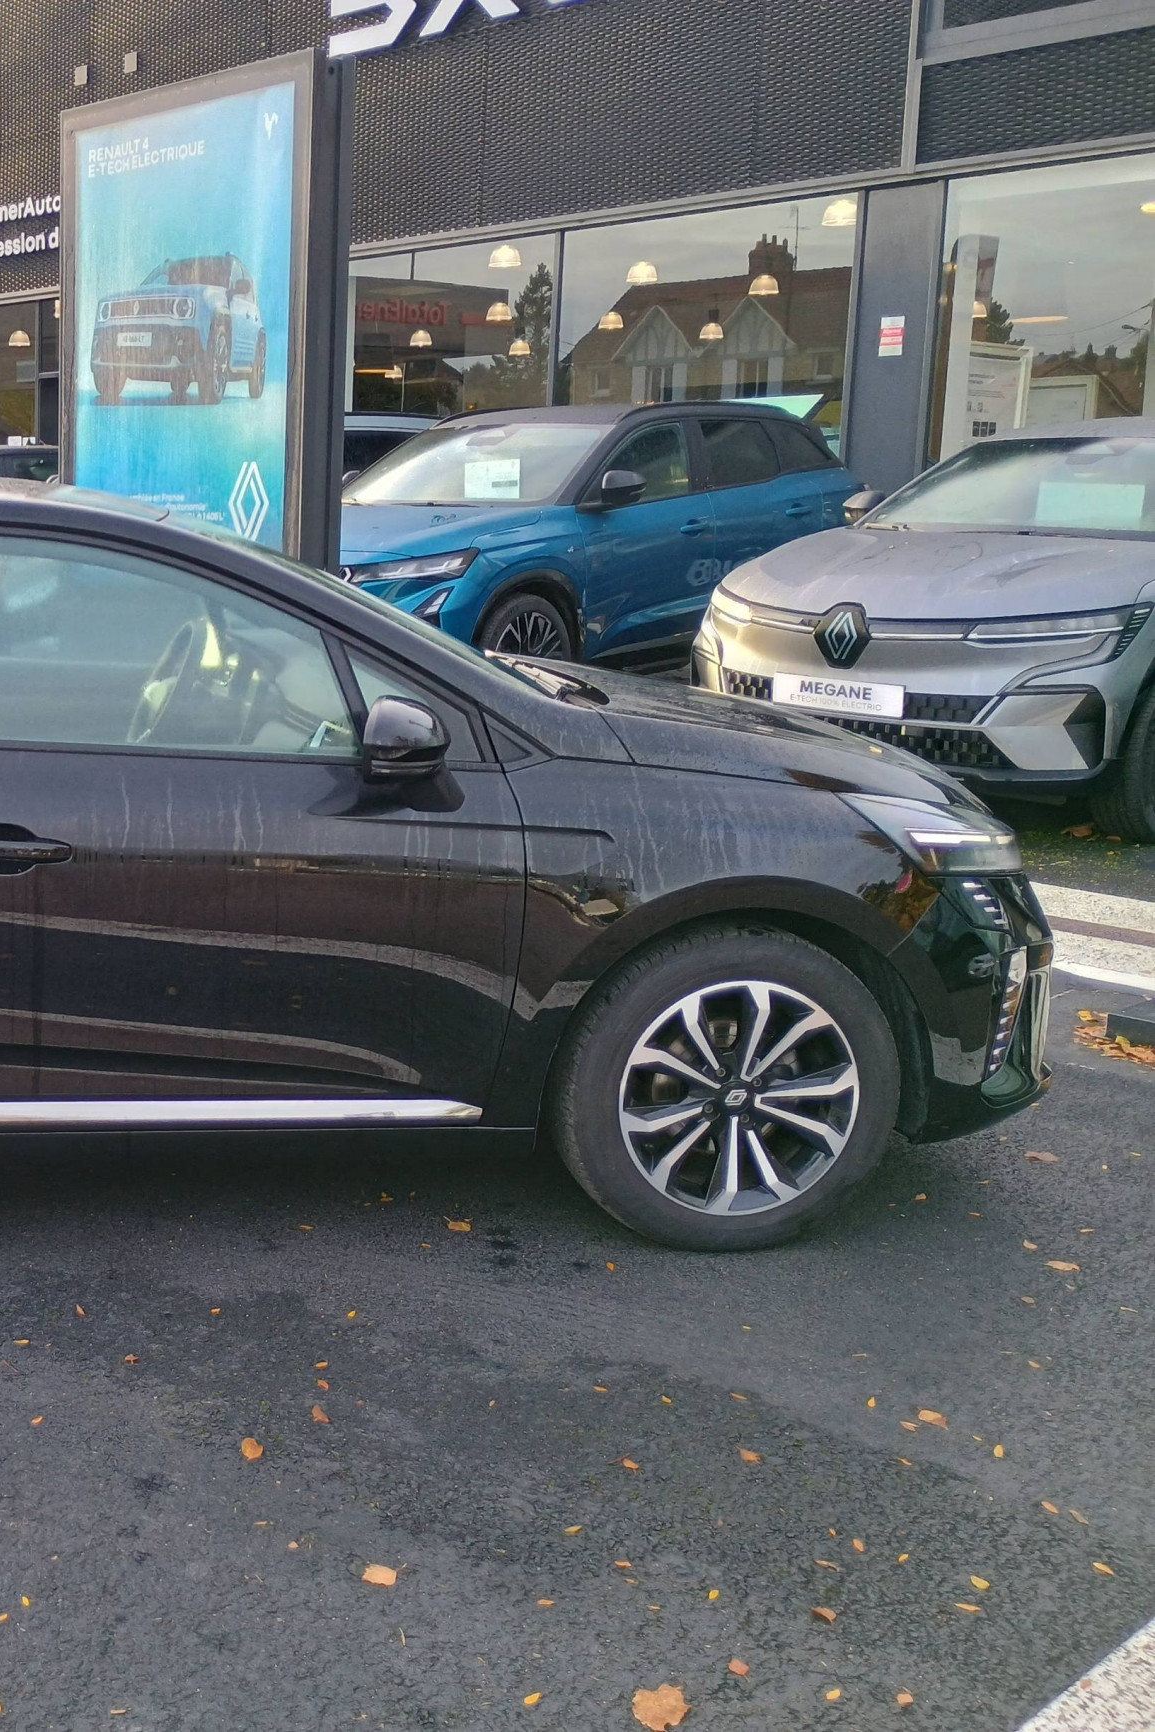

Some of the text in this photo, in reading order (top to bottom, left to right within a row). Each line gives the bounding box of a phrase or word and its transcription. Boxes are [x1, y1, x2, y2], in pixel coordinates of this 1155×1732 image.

[88, 138, 141, 163] RENAULT
[88, 158, 130, 178] E-TECH
[799, 680, 873, 701] MEGANE
[789, 693, 882, 712] E-TECH 100% ELECTRIC
